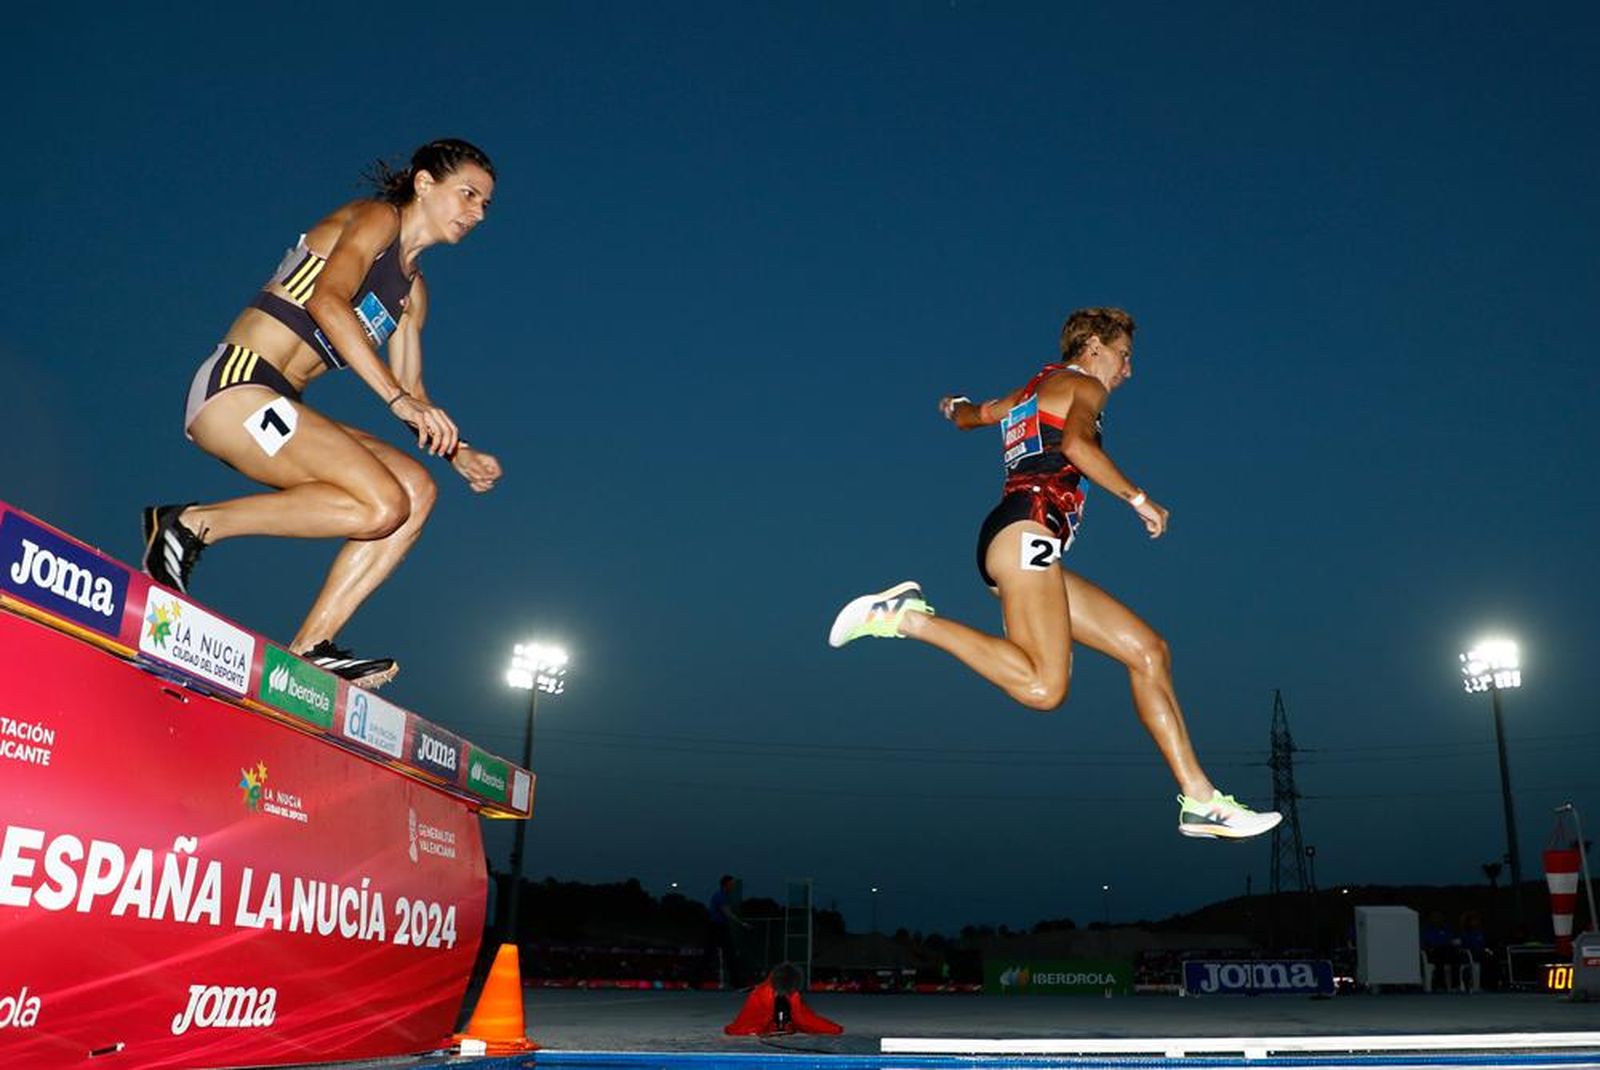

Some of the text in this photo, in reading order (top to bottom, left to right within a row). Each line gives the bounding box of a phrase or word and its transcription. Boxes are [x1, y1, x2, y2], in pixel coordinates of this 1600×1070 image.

[260, 407, 290, 437] 1
[1029, 539, 1054, 567] 2
[175, 622, 192, 647] LA
[172, 645, 245, 688] CIUDAD DEL DEPORTE
[0, 825, 458, 949] ESPAÑA LA NUCÍA 2024
[1032, 971, 1117, 986] IBERDROLA
